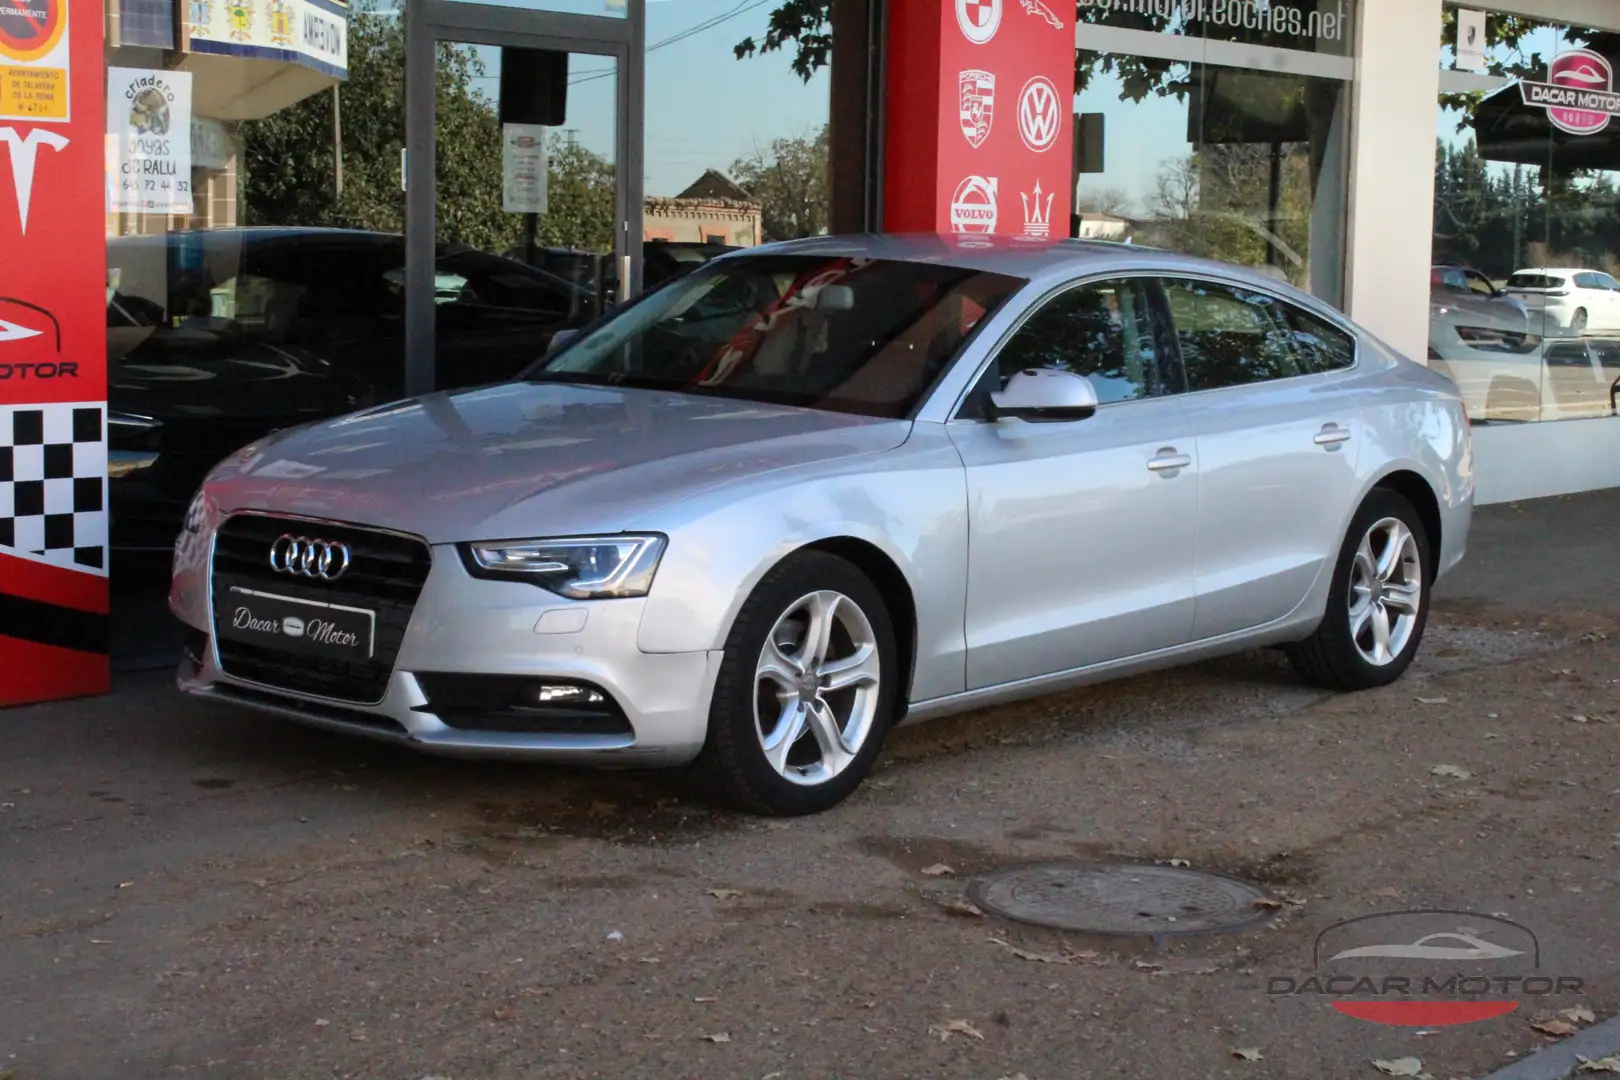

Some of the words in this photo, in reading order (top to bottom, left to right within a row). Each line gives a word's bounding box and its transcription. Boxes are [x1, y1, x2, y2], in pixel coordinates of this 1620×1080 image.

[0, 6, 47, 19] ERMANENTE
[125, 74, 174, 102] criadero
[1531, 86, 1576, 105] DACAR
[143, 159, 177, 175] RALU
[144, 179, 155, 191] 72
[177, 180, 188, 192] 32
[954, 208, 994, 220] VOLVO
[232, 606, 281, 635] Dacar
[306, 618, 360, 647] Motor
